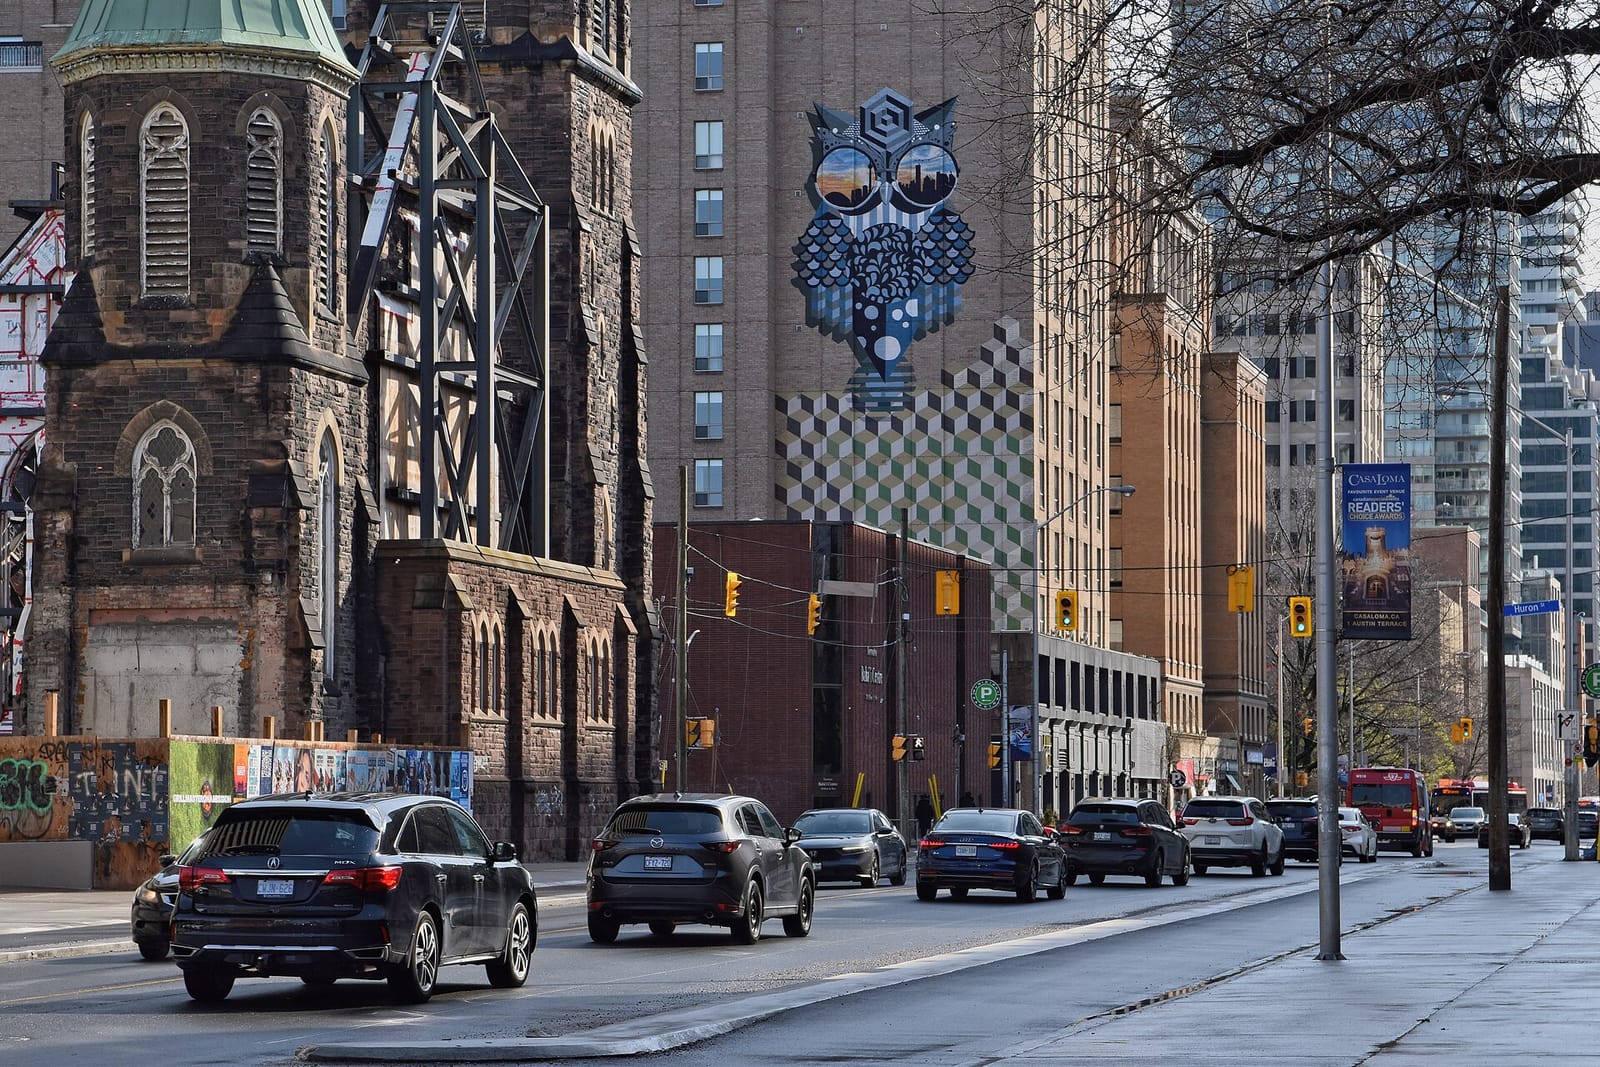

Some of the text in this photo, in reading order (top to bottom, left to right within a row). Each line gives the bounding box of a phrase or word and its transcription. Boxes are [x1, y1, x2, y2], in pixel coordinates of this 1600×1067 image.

[1348, 501, 1405, 512] READERS'
[1514, 604, 1539, 613] Huron
[980, 687, 993, 699] P
